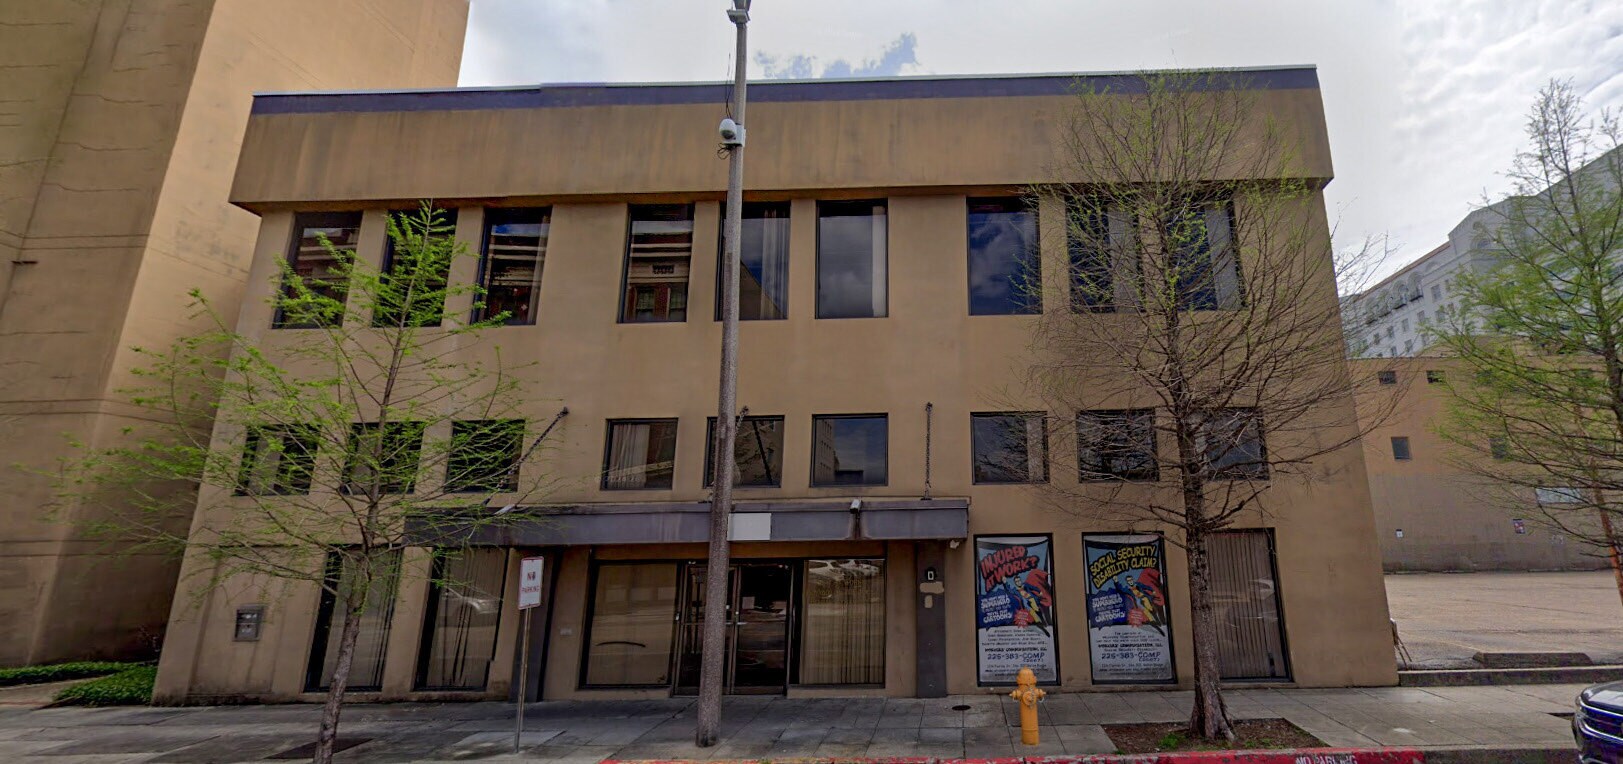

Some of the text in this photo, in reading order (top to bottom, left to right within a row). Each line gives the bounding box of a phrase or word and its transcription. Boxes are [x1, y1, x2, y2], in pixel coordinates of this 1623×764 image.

[981, 545, 1026, 578] INJURED
[1090, 545, 1156, 576] SOCIAL SECURITY
[527, 571, 536, 580] NO
[985, 556, 1038, 592] AT WORK?
[1093, 557, 1157, 588] DISABILITY CLAIM?
[987, 652, 1045, 660] 225-383-COMP
[1101, 651, 1161, 660] 225-383-COMP
[1295, 756, 1312, 764] NO
